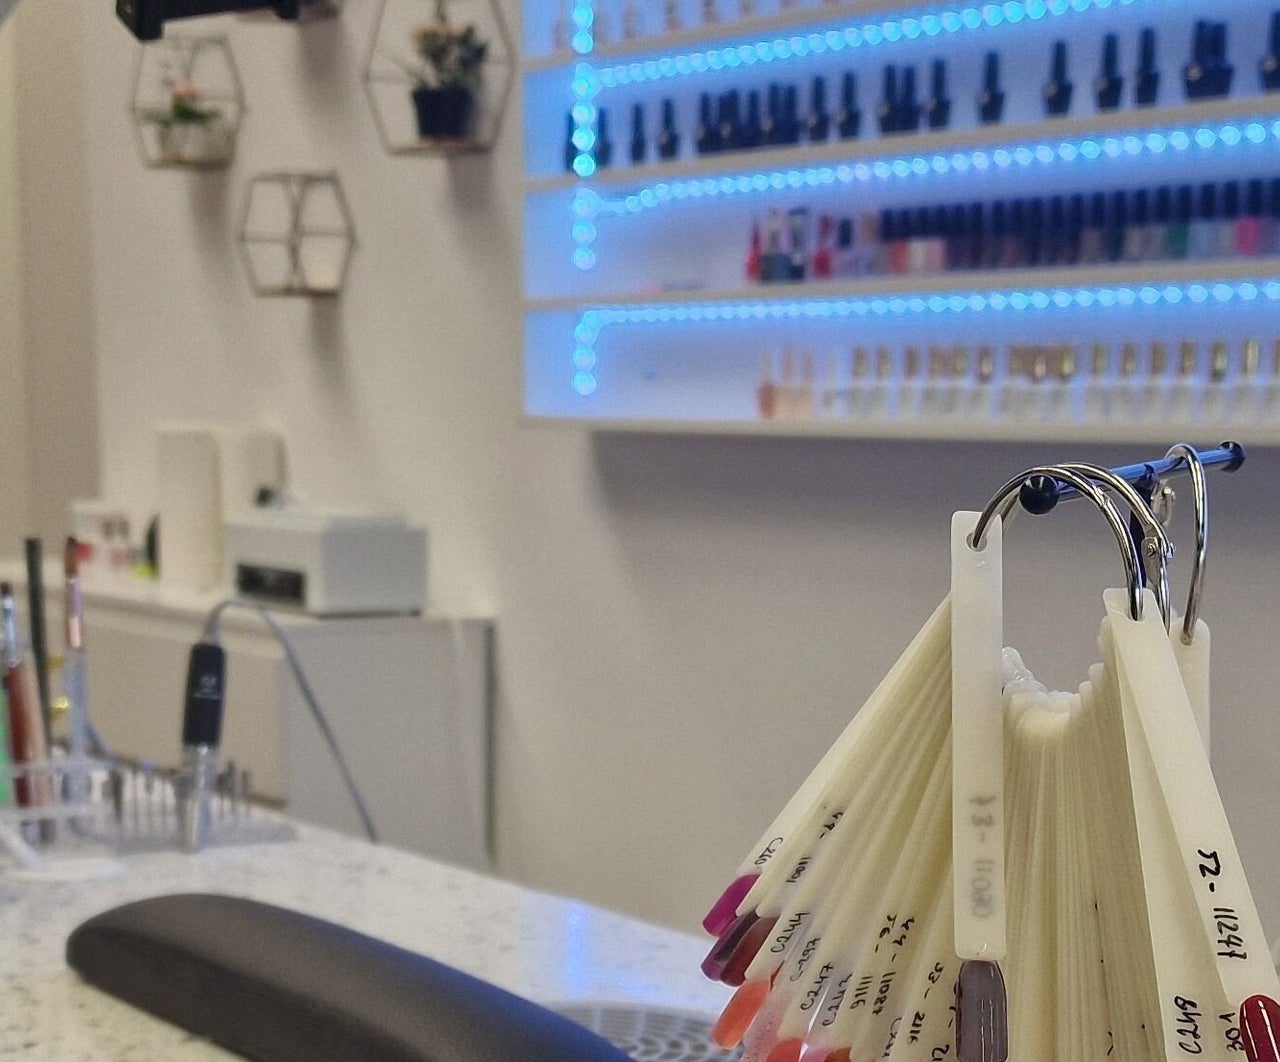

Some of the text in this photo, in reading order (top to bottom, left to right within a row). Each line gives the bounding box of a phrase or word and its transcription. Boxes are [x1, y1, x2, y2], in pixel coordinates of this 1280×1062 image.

[771, 912, 811, 953] C244
[1213, 907, 1247, 960] 11247
[800, 962, 834, 1011] C247
